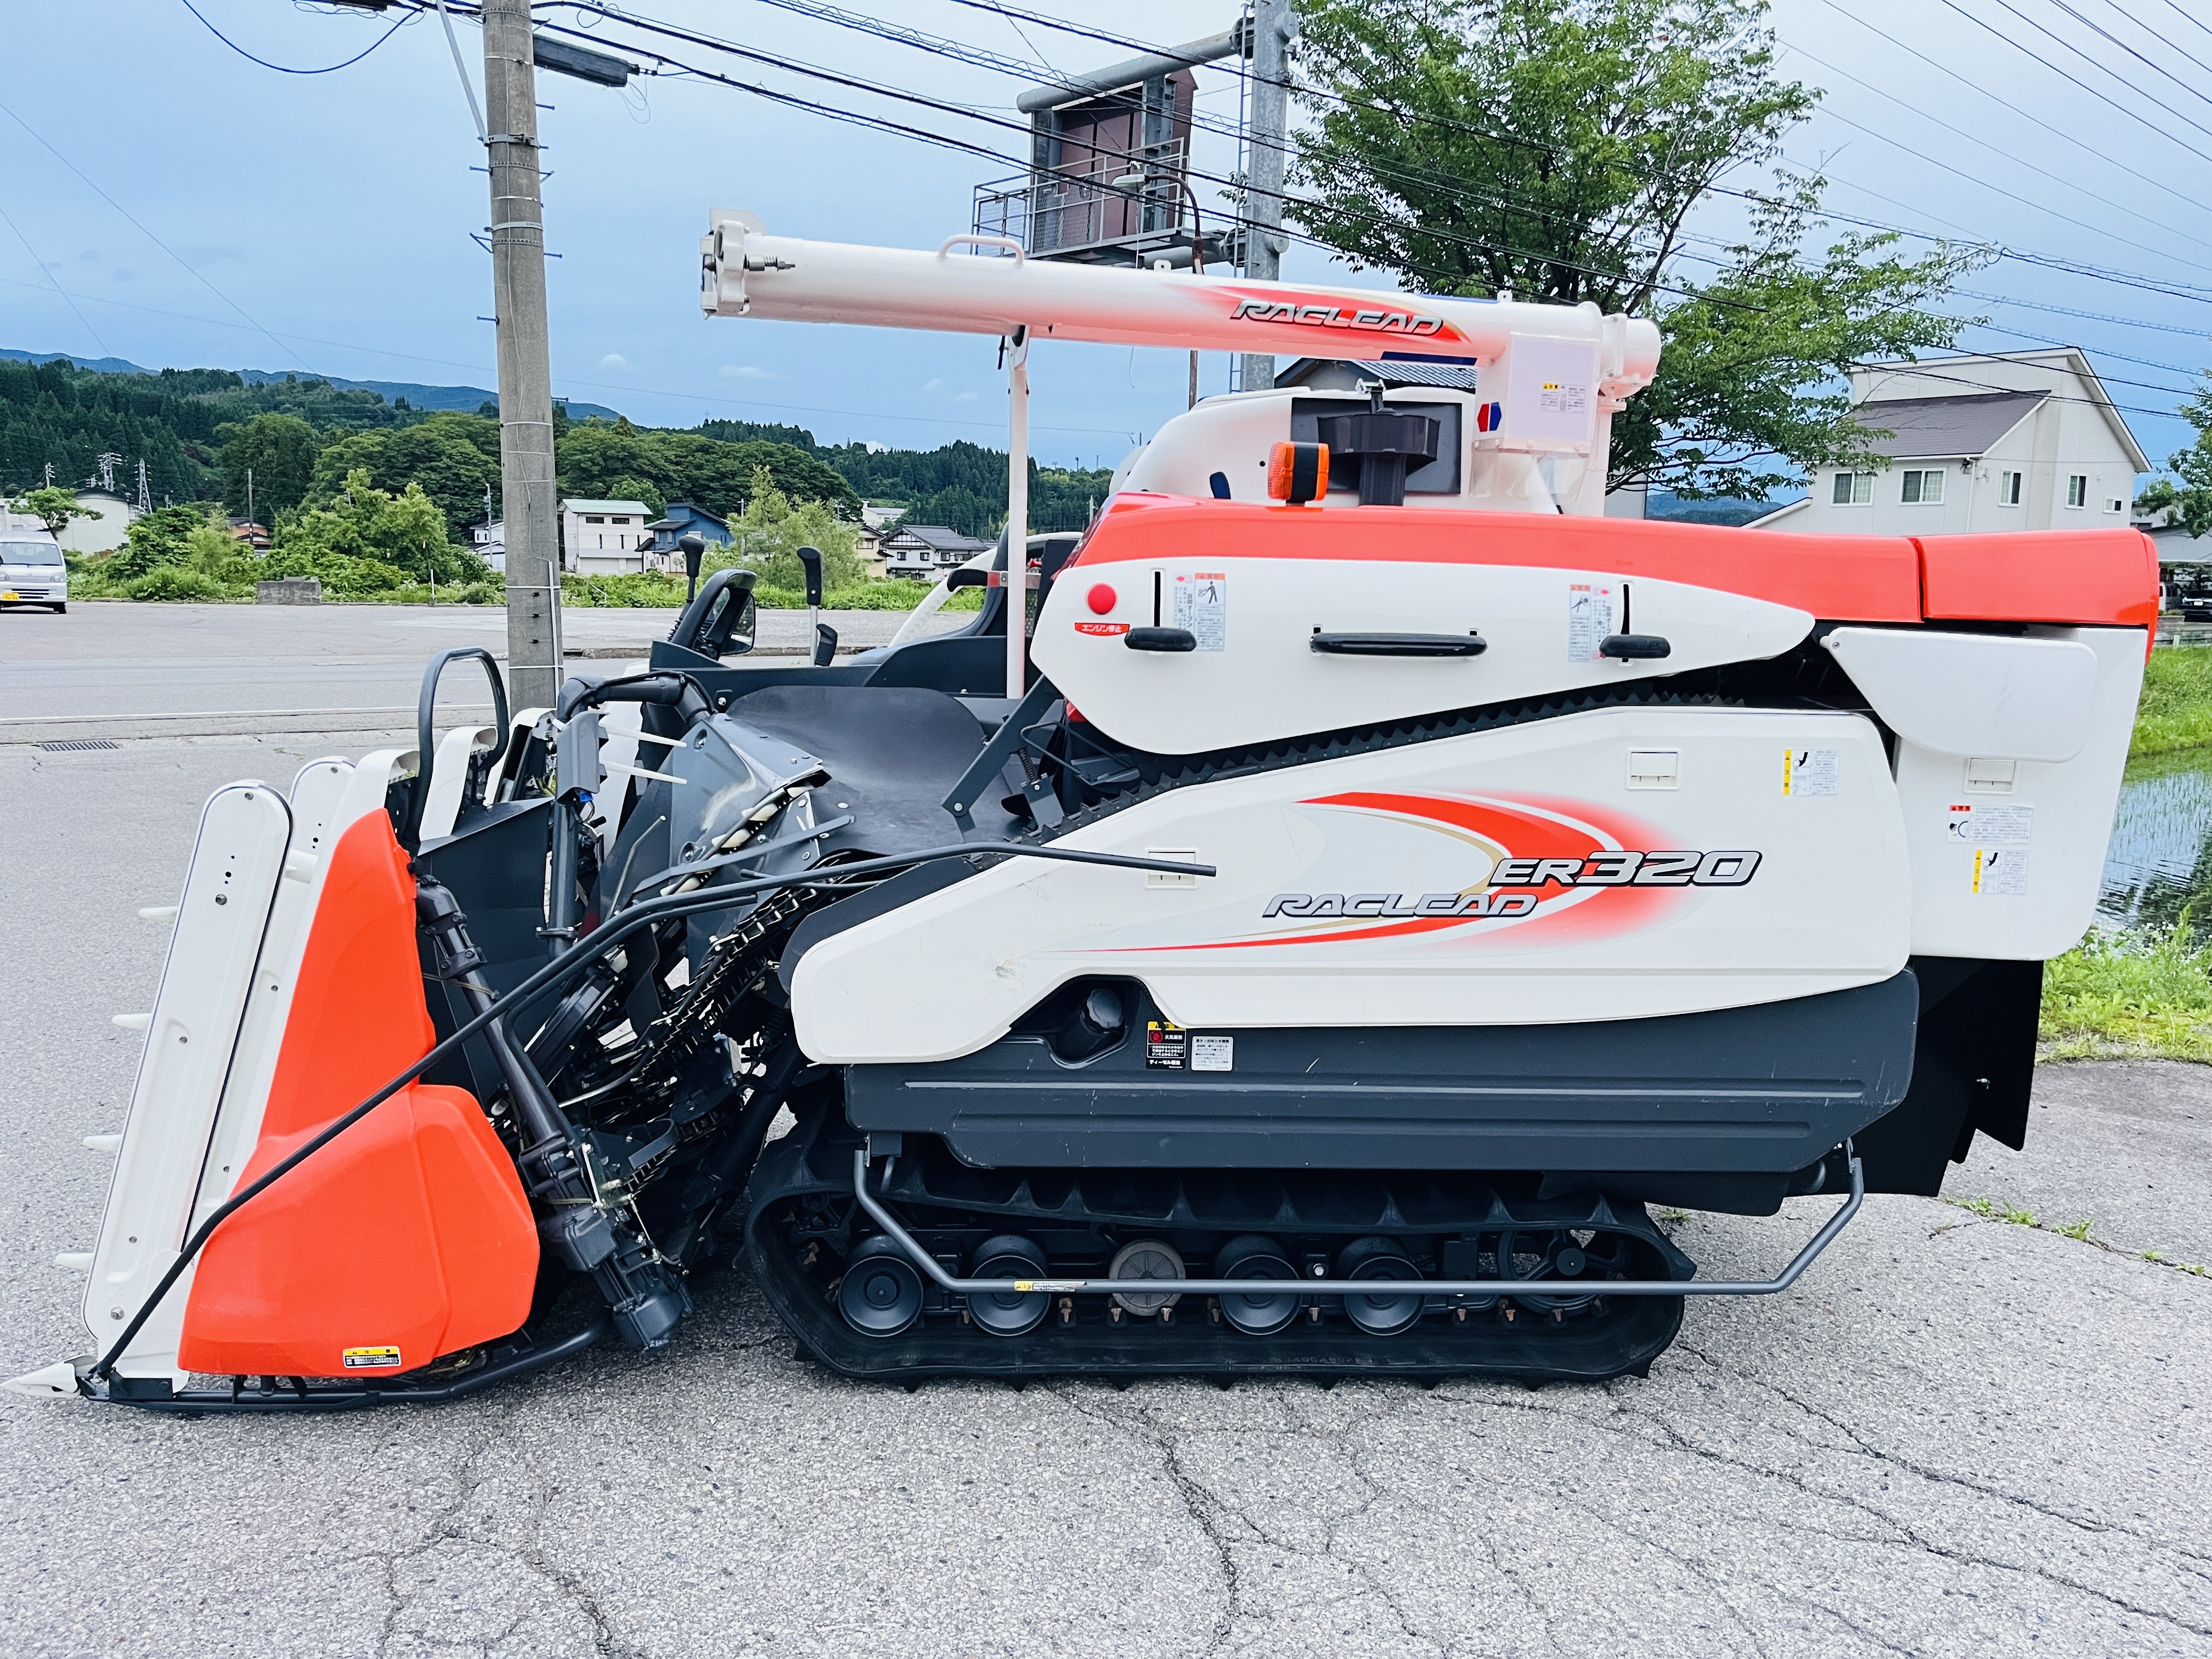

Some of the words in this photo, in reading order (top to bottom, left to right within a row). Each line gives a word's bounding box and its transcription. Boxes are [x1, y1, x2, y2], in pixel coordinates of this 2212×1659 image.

[1229, 300, 1443, 336] RACLEAD
[1488, 851, 1763, 887] ER320
[1262, 894, 1538, 917] RACLEAD
